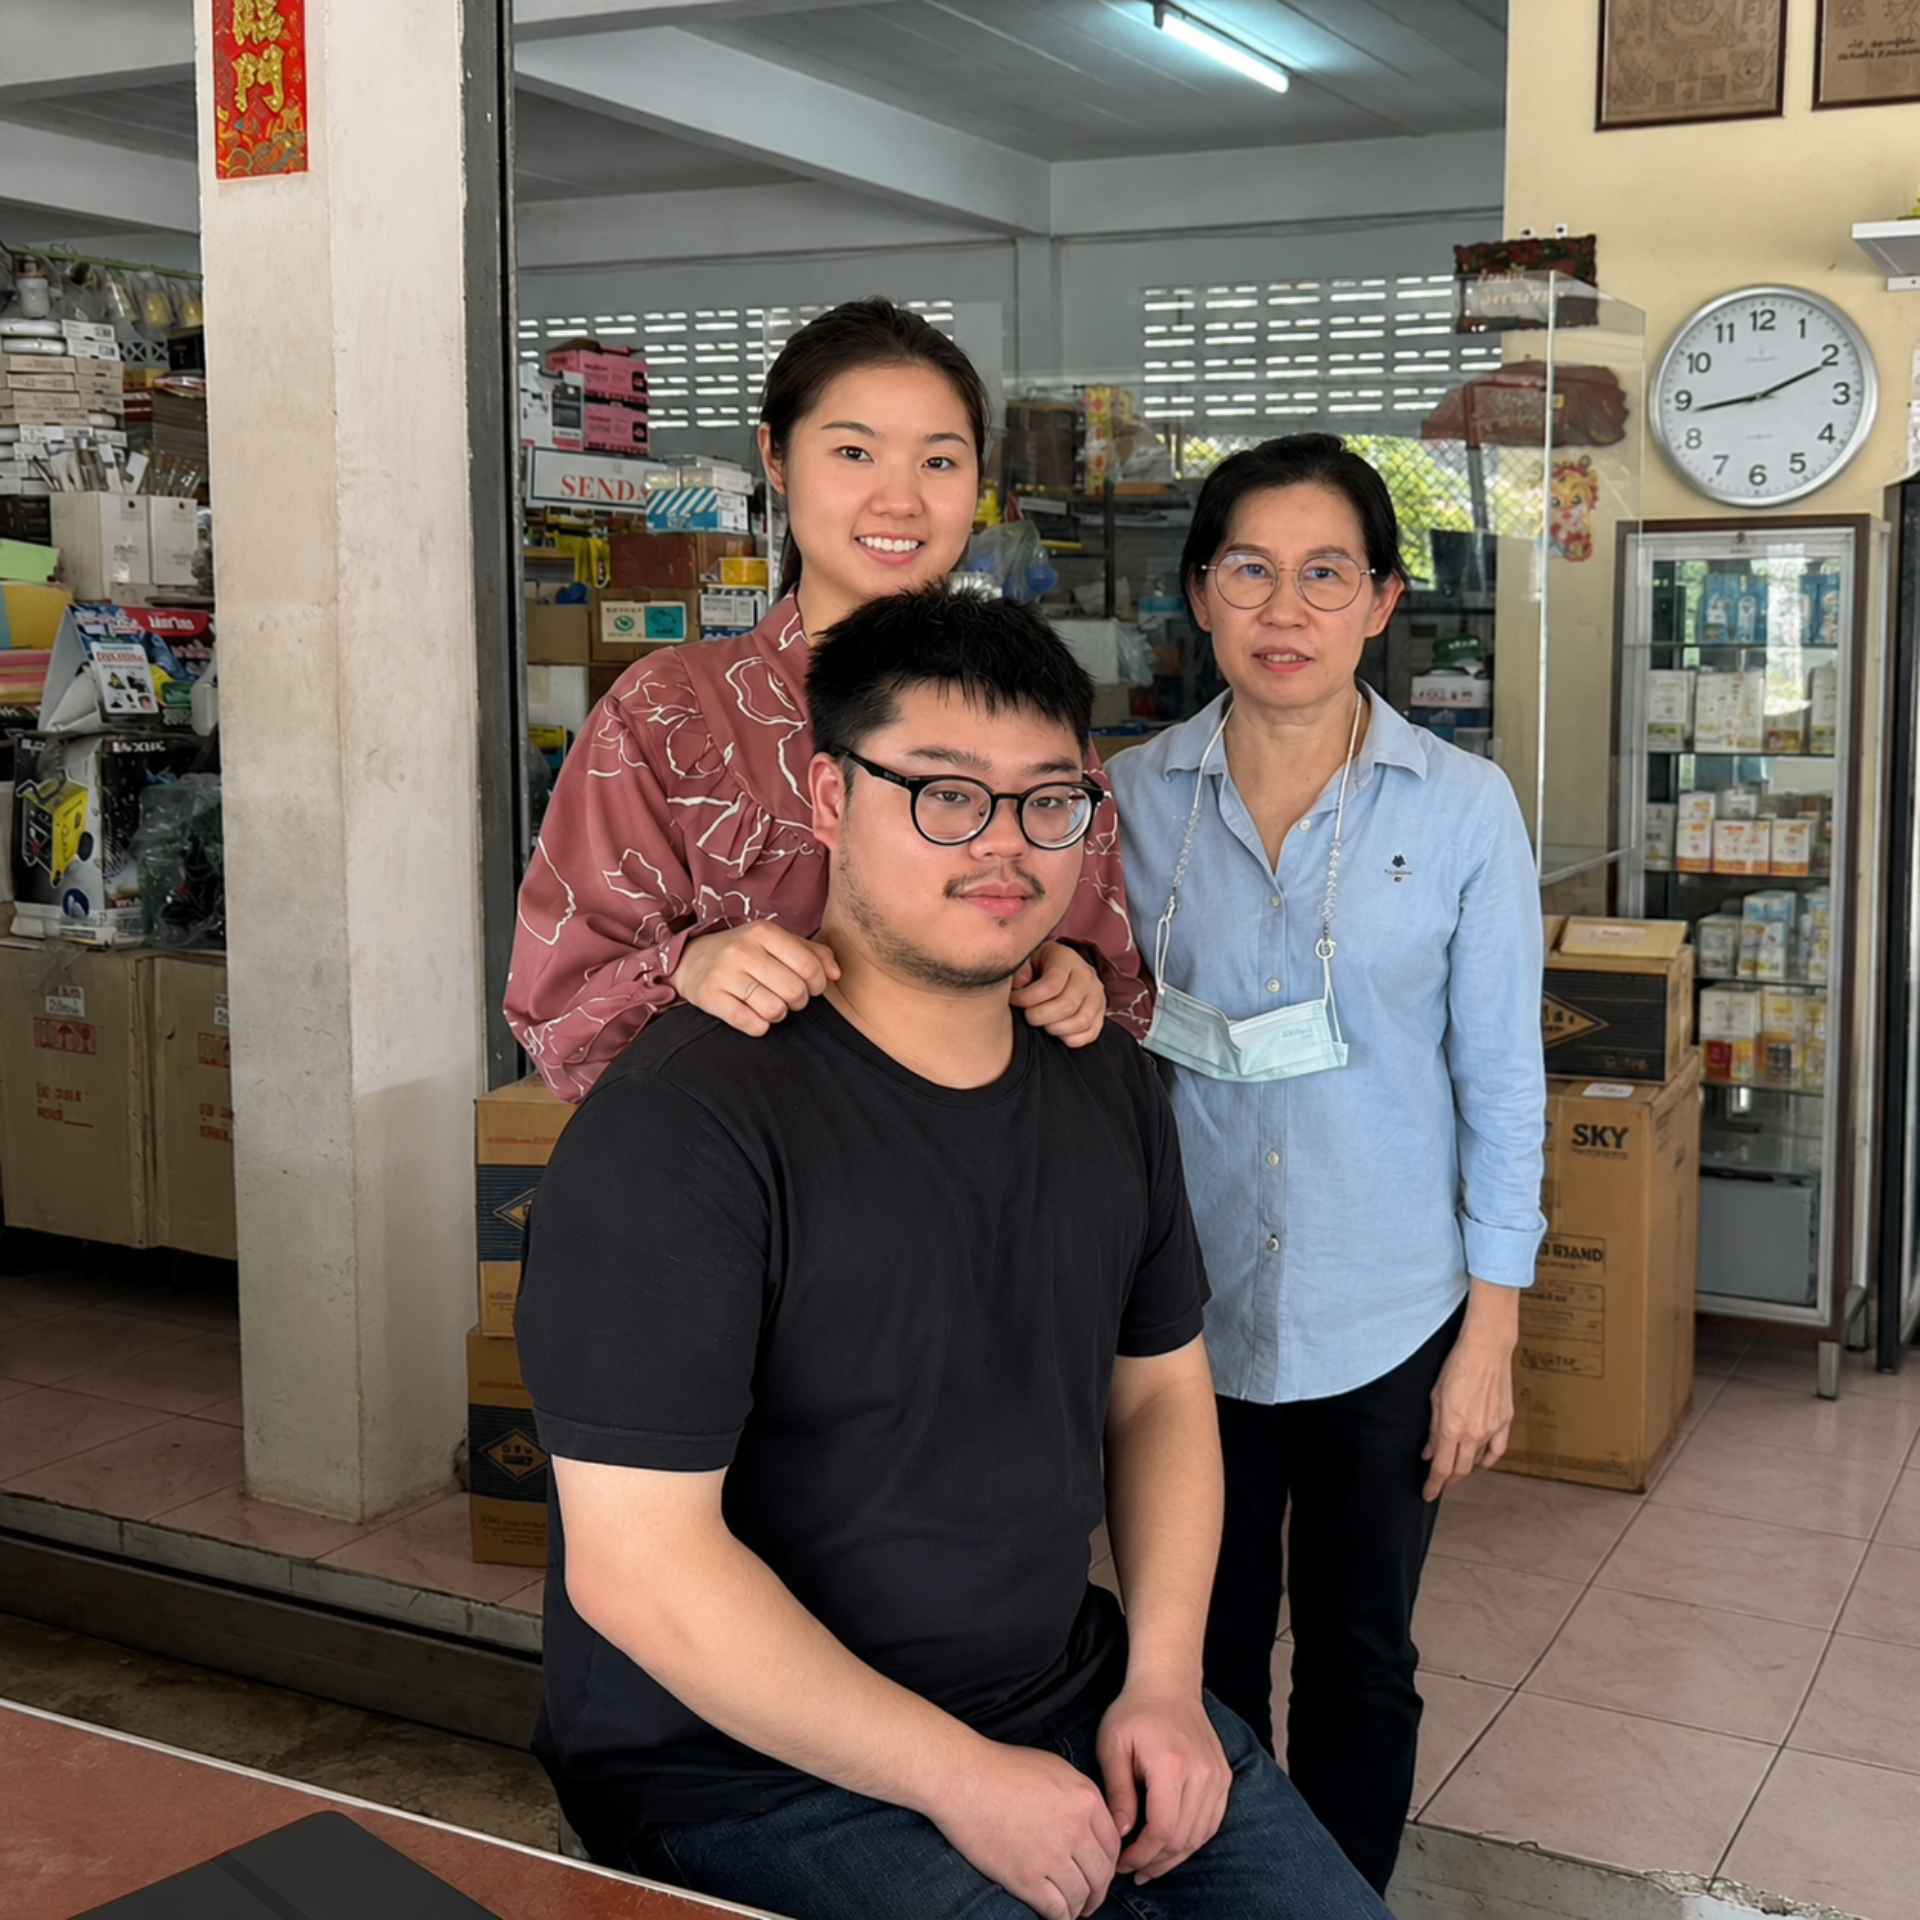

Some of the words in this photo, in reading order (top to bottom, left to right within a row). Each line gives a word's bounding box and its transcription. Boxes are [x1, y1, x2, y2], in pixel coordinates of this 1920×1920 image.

[1750, 309, 1776, 331] 12
[1798, 318, 1806, 339] 1
[1716, 322, 1735, 343] 11
[1688, 352, 1711, 374] 10
[1821, 344, 1839, 366] 2
[1675, 390, 1692, 411] 9
[1832, 382, 1851, 405] 3
[1685, 428, 1702, 449] 8
[1817, 423, 1836, 444] 4
[1713, 454, 1729, 476] 7
[1789, 452, 1807, 474] 5
[1749, 464, 1767, 486] 6
[1571, 1122, 1629, 1149] SKY
